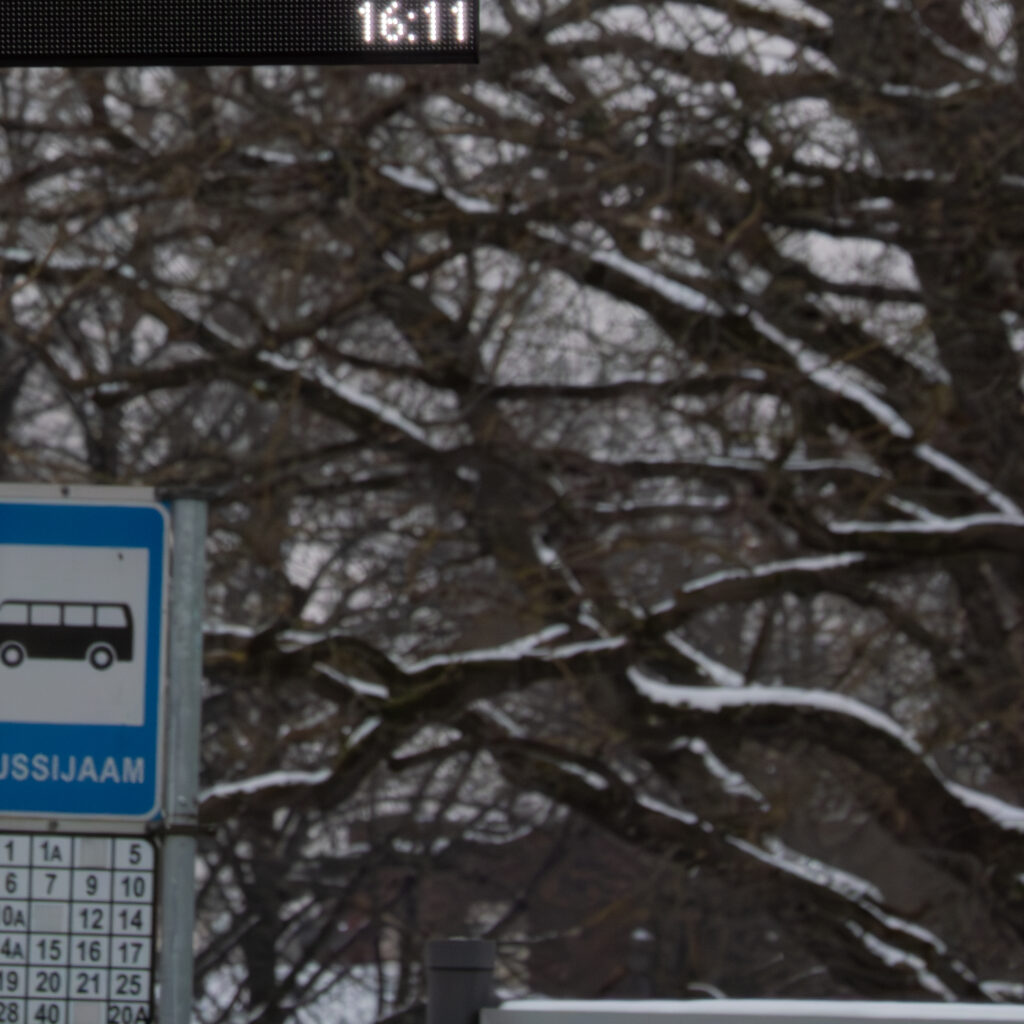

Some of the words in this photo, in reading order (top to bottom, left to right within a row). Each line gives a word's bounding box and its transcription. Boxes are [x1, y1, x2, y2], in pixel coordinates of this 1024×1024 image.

[358, 1, 466, 43] 16:11
[4, 840, 15, 861] 1
[40, 841, 63, 862] 1A
[128, 844, 142, 865] 5
[5, 873, 17, 894] 6
[45, 874, 57, 895] 7
[85, 875, 98, 896] 9
[122, 877, 146, 898] 10
[79, 908, 104, 930] 12
[119, 909, 143, 930] 14
[37, 939, 62, 961] 15
[77, 941, 102, 962] 16
[118, 942, 143, 963] 17
[36, 972, 61, 993] 20
[77, 973, 101, 994] 21
[116, 974, 142, 995] 25
[34, 1003, 60, 1024] 40
